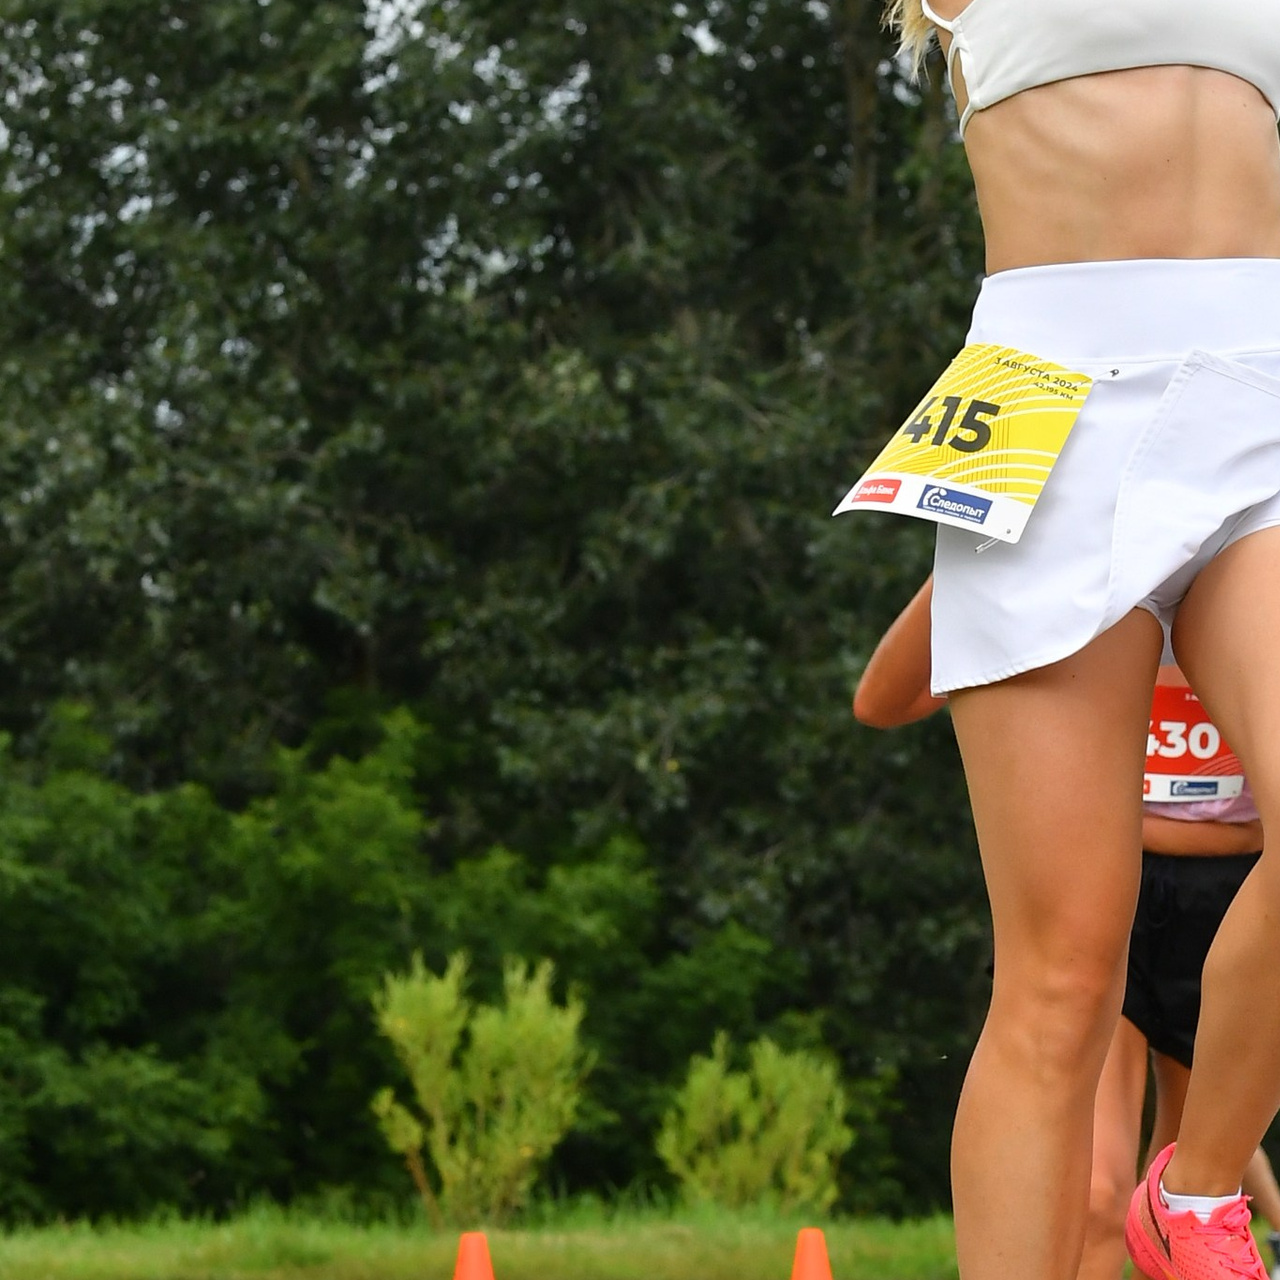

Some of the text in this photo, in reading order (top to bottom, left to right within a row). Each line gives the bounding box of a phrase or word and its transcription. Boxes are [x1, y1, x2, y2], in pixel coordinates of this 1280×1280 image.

[1002, 360, 1050, 381] АВГУСТА
[1053, 377, 1078, 392] 2024
[1033, 381, 1058, 395] 42,195
[902, 396, 1001, 453] 415
[930, 495, 985, 518] Следопыт
